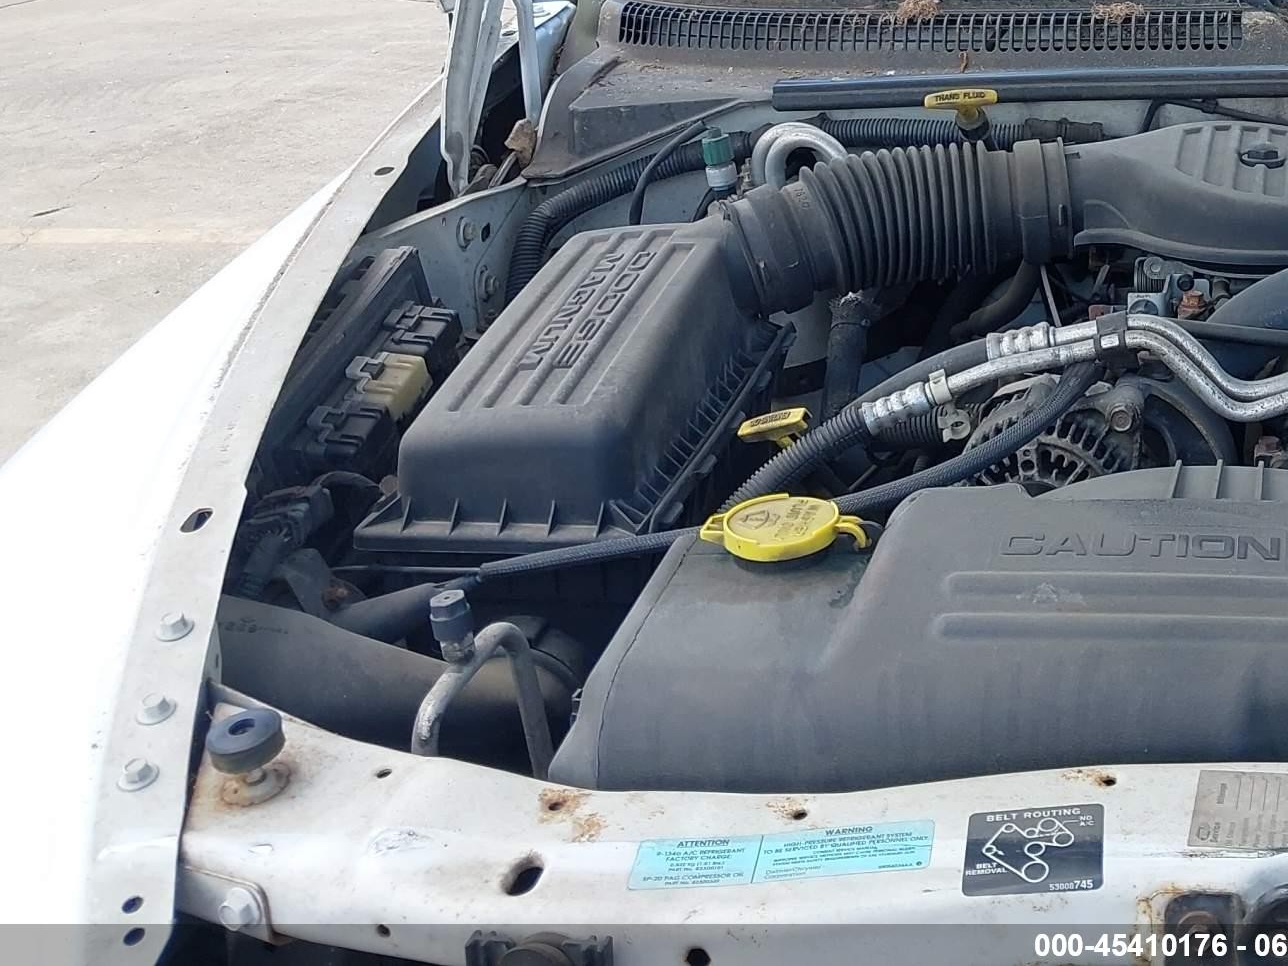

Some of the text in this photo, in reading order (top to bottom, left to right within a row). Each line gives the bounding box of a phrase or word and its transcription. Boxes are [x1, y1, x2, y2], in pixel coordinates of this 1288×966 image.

[935, 91, 986, 102] TRANS FLUID
[517, 252, 625, 371] MAGNUM
[553, 251, 657, 369] DODGE
[1000, 532, 1282, 561] CAUTION
[985, 807, 1081, 823] BELT ROUTING
[824, 826, 873, 836] WARNING
[676, 839, 731, 849] ATTENTION
[965, 867, 1008, 876] REMOVAL
[975, 862, 998, 870] BELT
